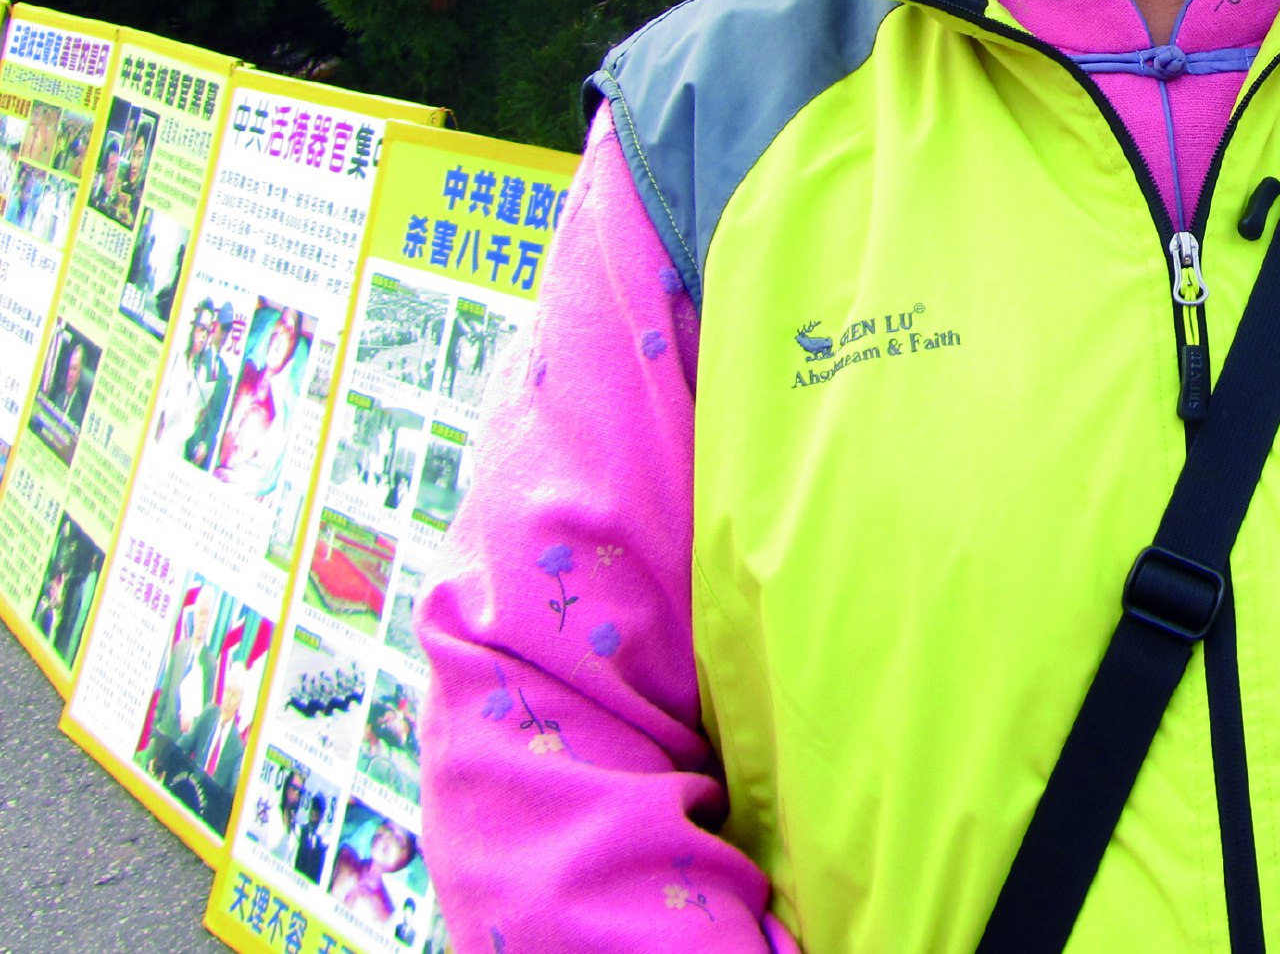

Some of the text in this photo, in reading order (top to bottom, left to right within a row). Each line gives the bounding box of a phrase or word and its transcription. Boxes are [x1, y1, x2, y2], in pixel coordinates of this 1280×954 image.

[402, 214, 545, 290] 杀害八千万
[909, 330, 961, 353] Faith
